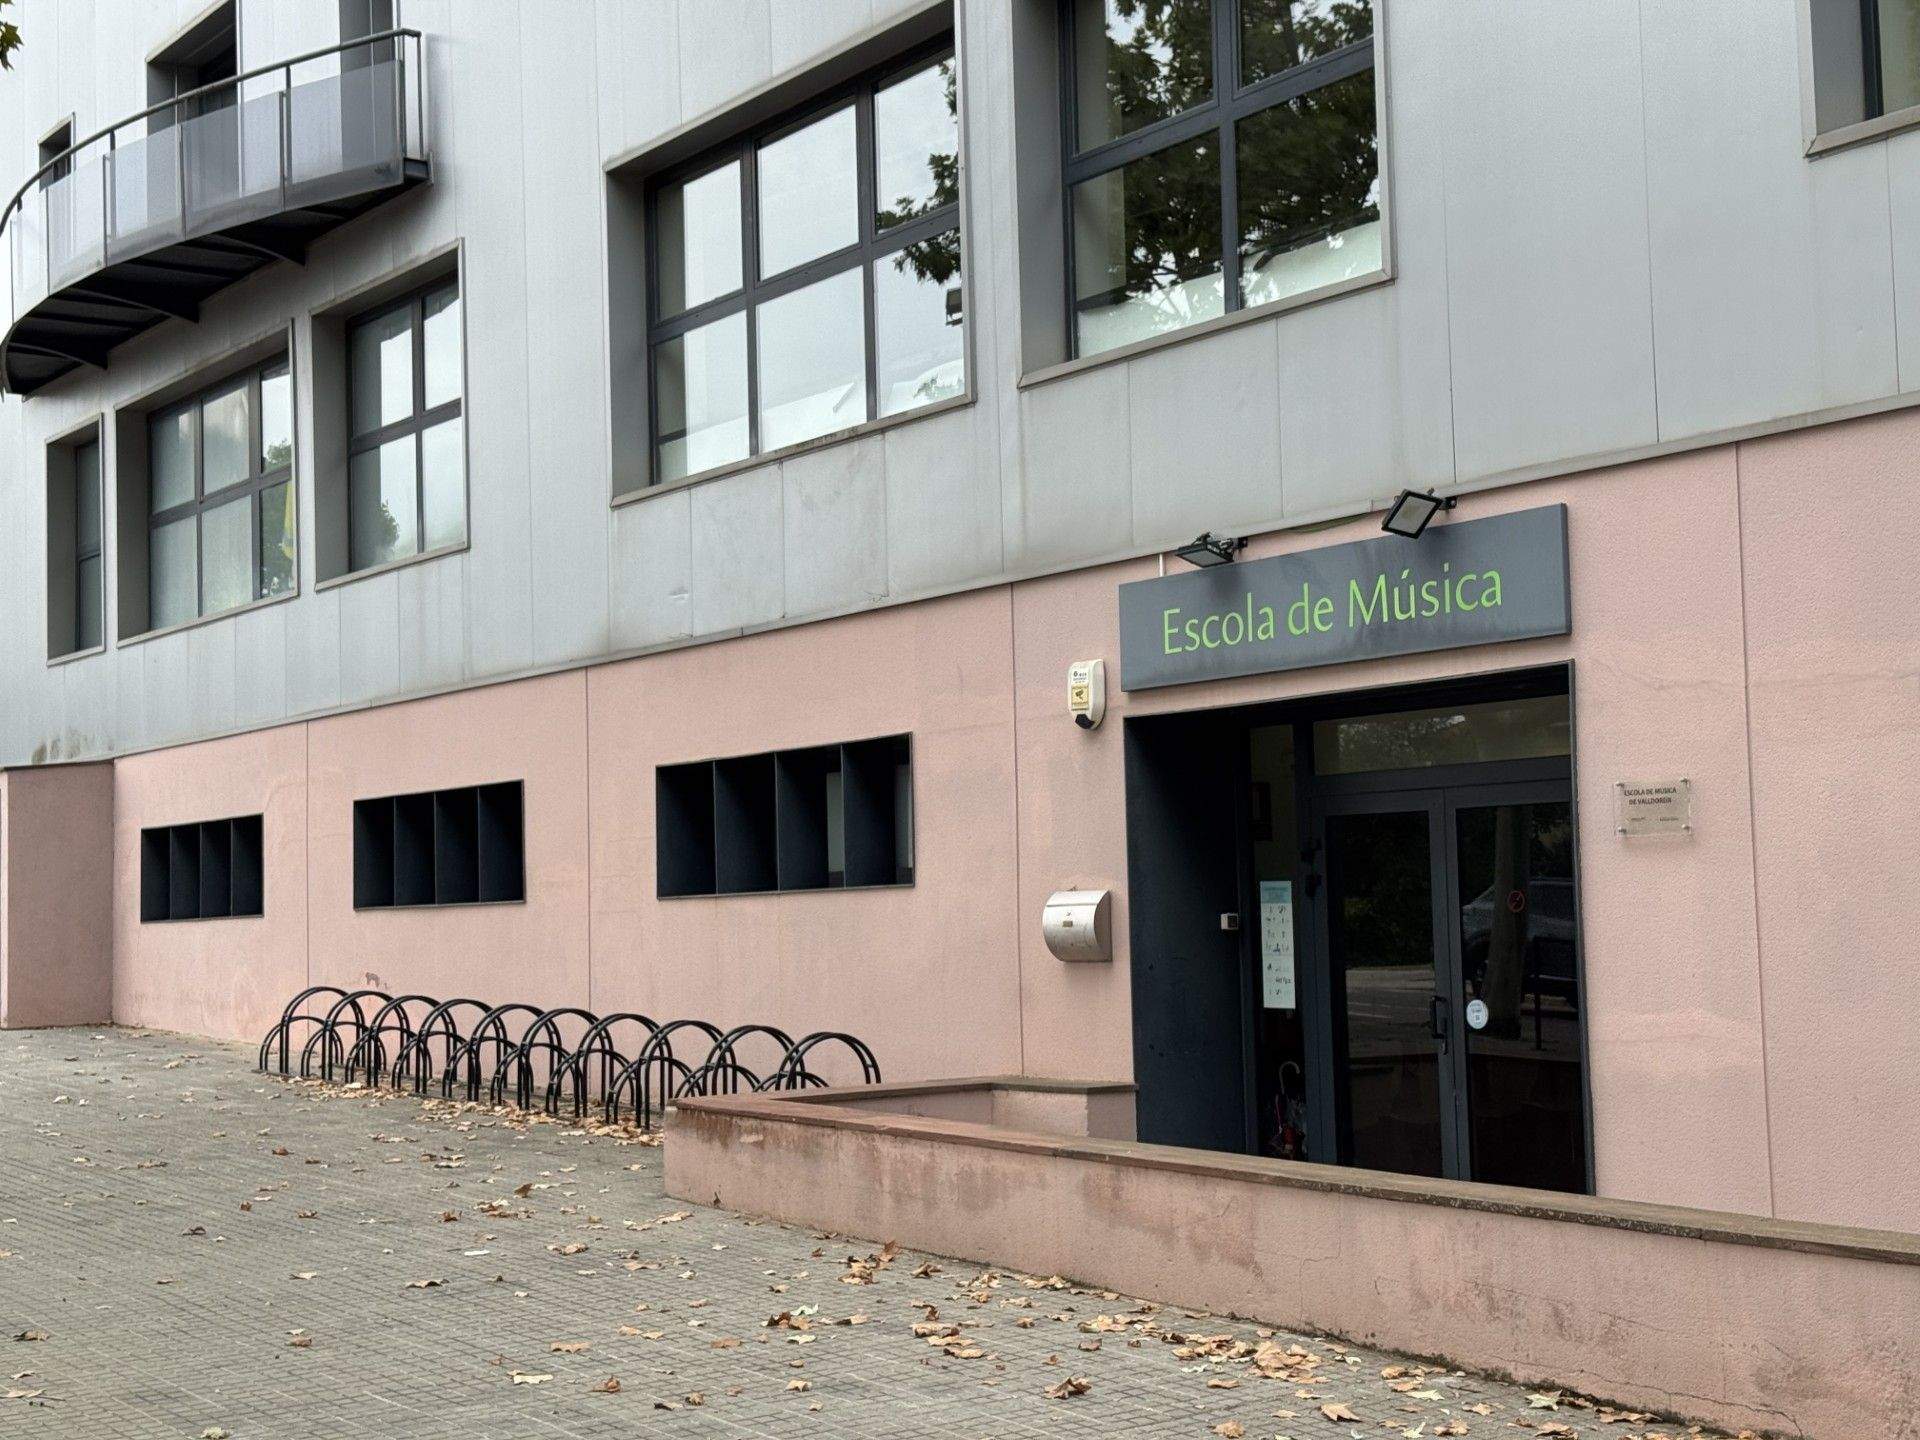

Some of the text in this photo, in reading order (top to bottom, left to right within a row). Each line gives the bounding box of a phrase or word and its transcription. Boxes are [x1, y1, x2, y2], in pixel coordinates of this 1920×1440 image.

[1162, 562, 1504, 655] Escola de Música
